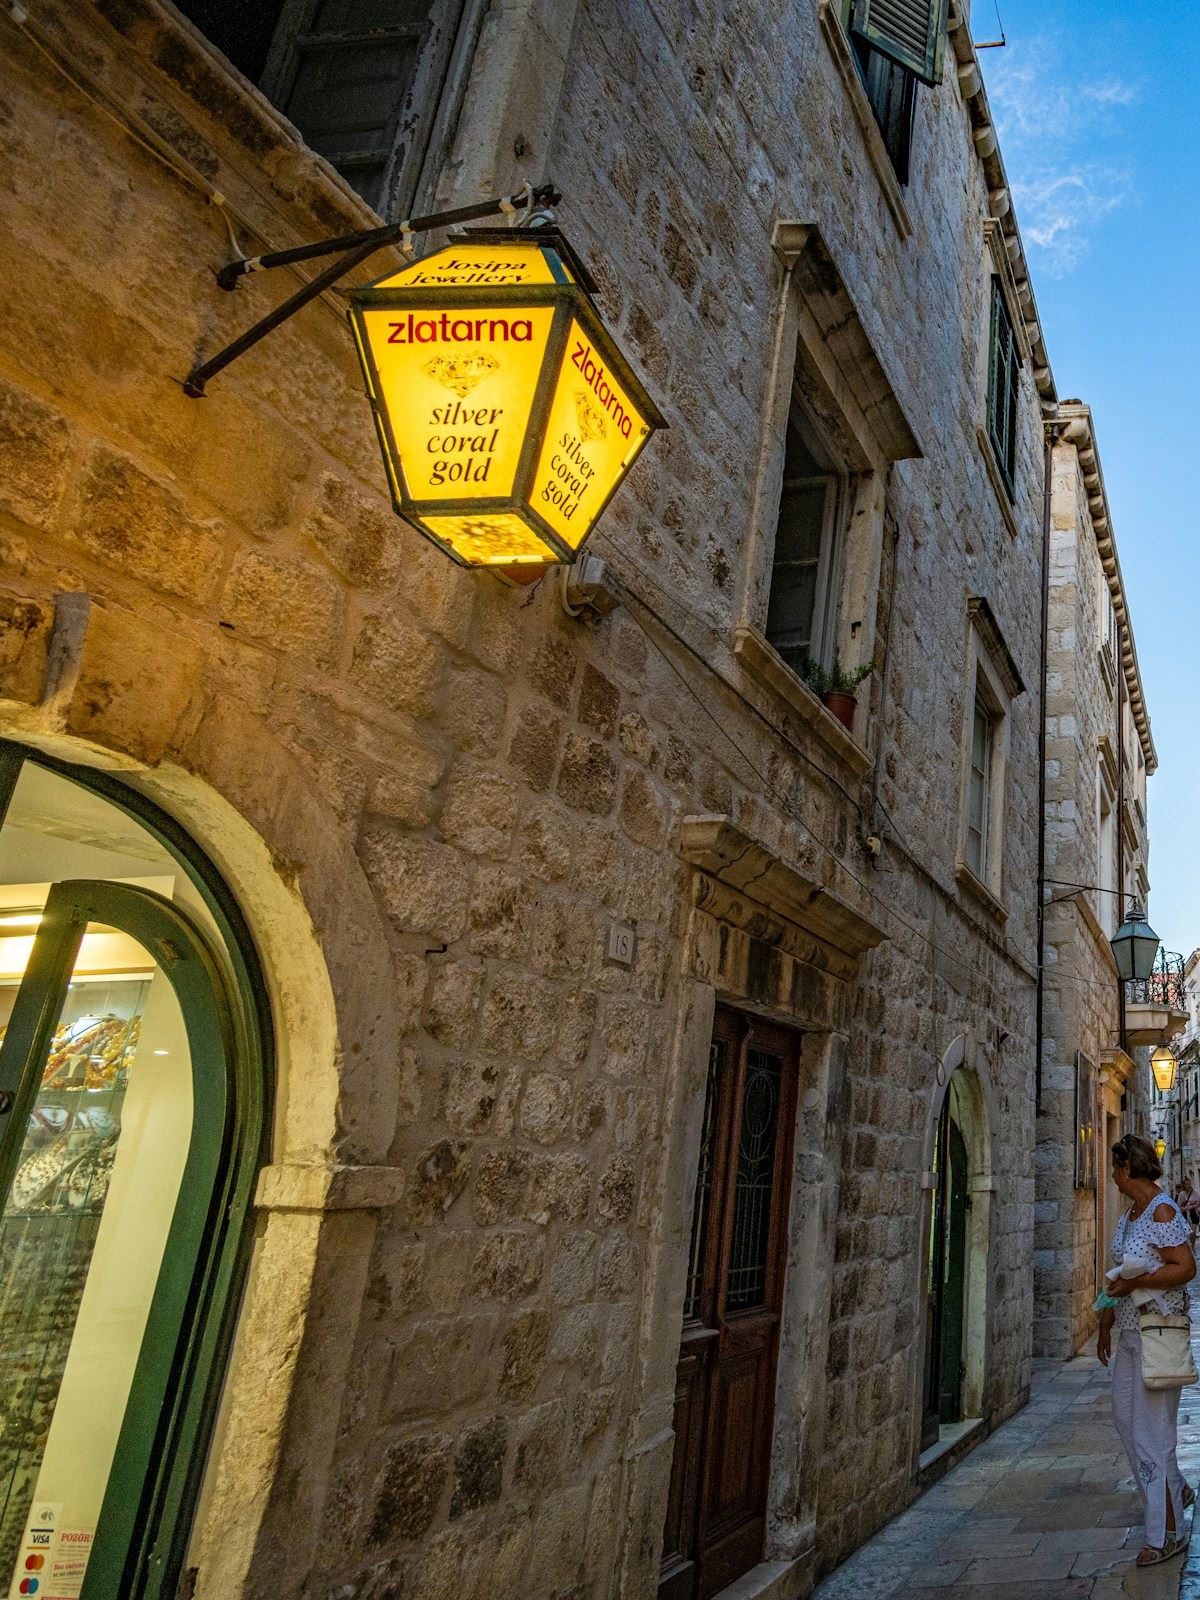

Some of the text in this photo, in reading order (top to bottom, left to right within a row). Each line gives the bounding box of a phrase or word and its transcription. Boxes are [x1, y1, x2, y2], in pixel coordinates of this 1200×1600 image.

[404, 271, 531, 285] jewellery
[438, 260, 527, 272] Josipa
[388, 313, 532, 344] zlatarna
[571, 341, 632, 440] zlatarna
[429, 402, 503, 426] silver
[427, 429, 499, 453] coral
[559, 432, 595, 481] silver
[429, 457, 492, 485] gold
[551, 455, 588, 501] coral
[541, 480, 579, 521] gold
[616, 935, 629, 956] 18
[33, 1535, 50, 1543] VISA
